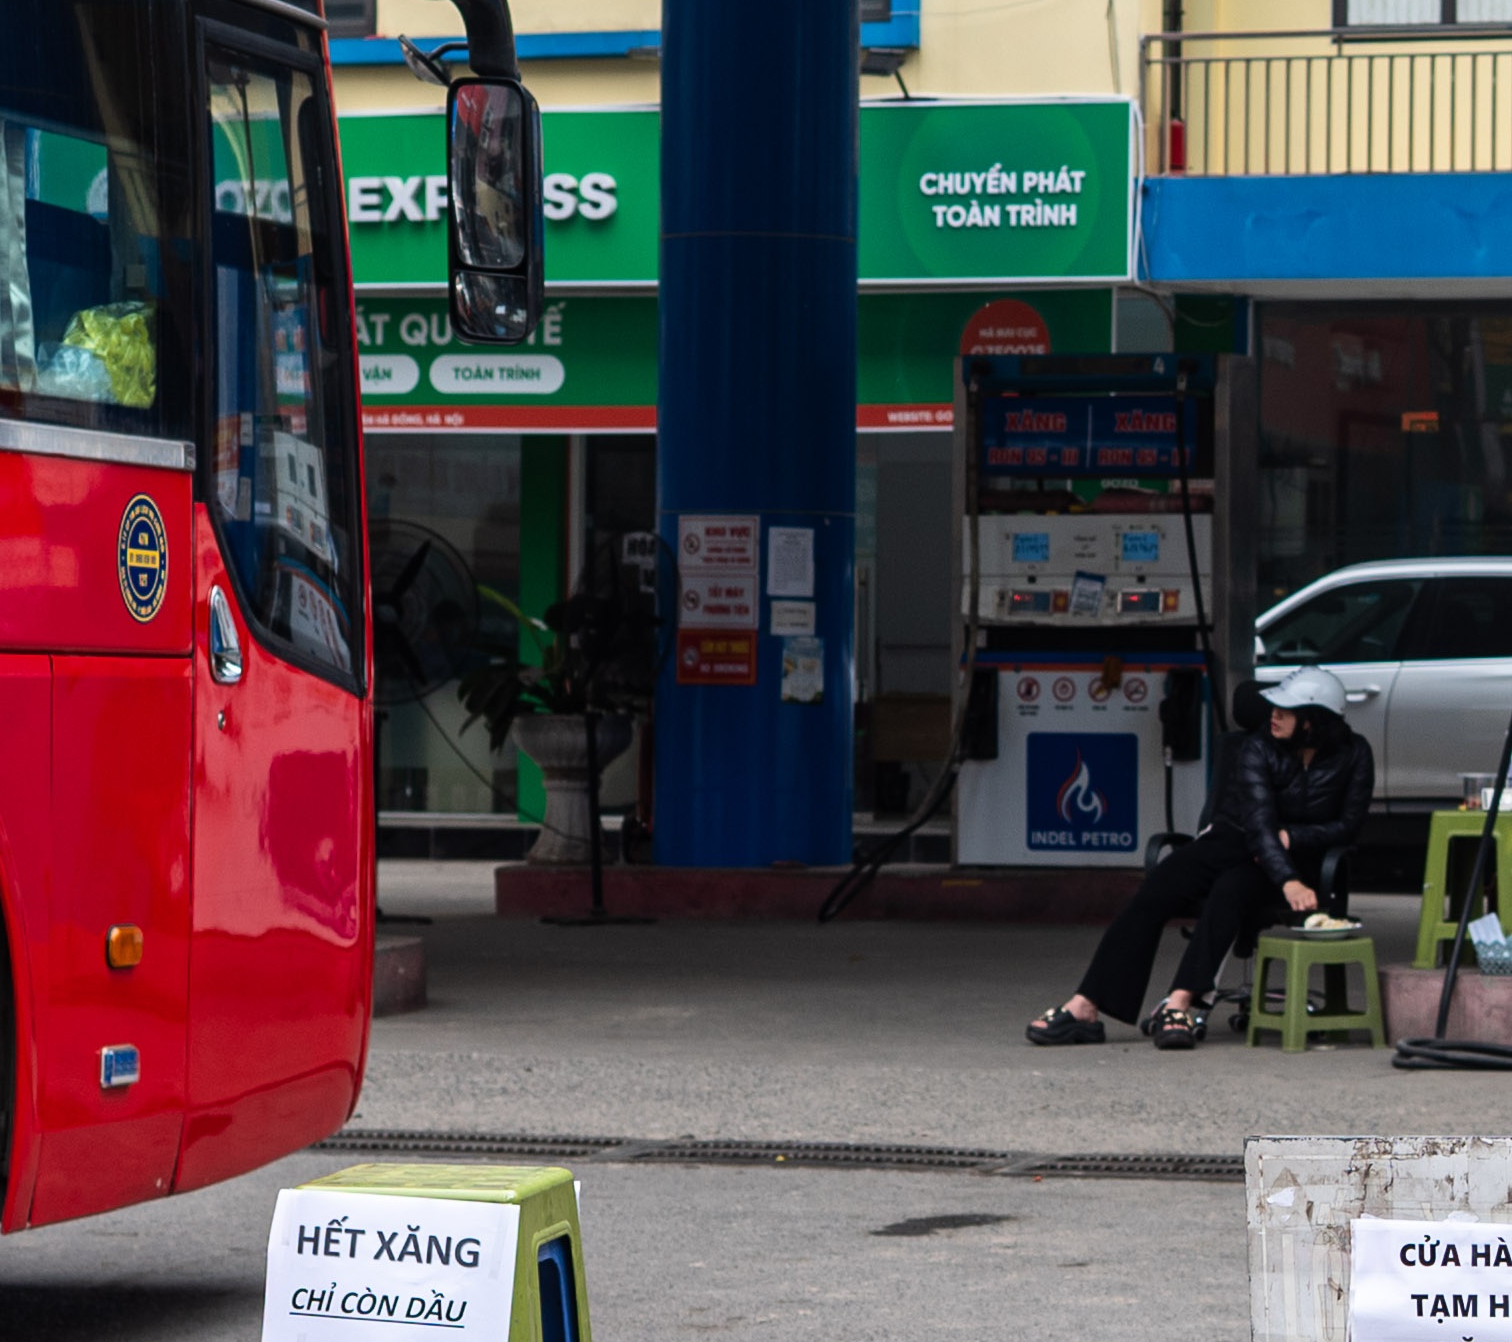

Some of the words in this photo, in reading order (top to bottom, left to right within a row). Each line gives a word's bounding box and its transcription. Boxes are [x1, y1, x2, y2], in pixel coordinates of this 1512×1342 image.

[919, 163, 1014, 196] CHUYỂN
[1023, 165, 1086, 194] PHÁT
[348, 172, 618, 223] EXPSS
[932, 199, 999, 228] TOÀN
[1007, 198, 1078, 227] TRÌNH
[363, 365, 392, 387] VẬN
[453, 362, 494, 381] TOÀN
[498, 362, 541, 381] TRÌNH
[1153, 357, 1165, 374] 4
[1004, 407, 1067, 434] XĂNG
[1114, 406, 1177, 434] XĂNG
[1031, 831, 1074, 847] INDEL
[1081, 831, 1132, 847] PETRO
[296, 1215, 366, 1259] HẾT
[373, 1224, 481, 1268] XĂNG
[1399, 1234, 1462, 1268] CỬA
[291, 1281, 338, 1312] CHỈ
[340, 1286, 399, 1318] CÒN
[405, 1289, 467, 1323] DẦU
[1411, 1294, 1479, 1325] TẠM
